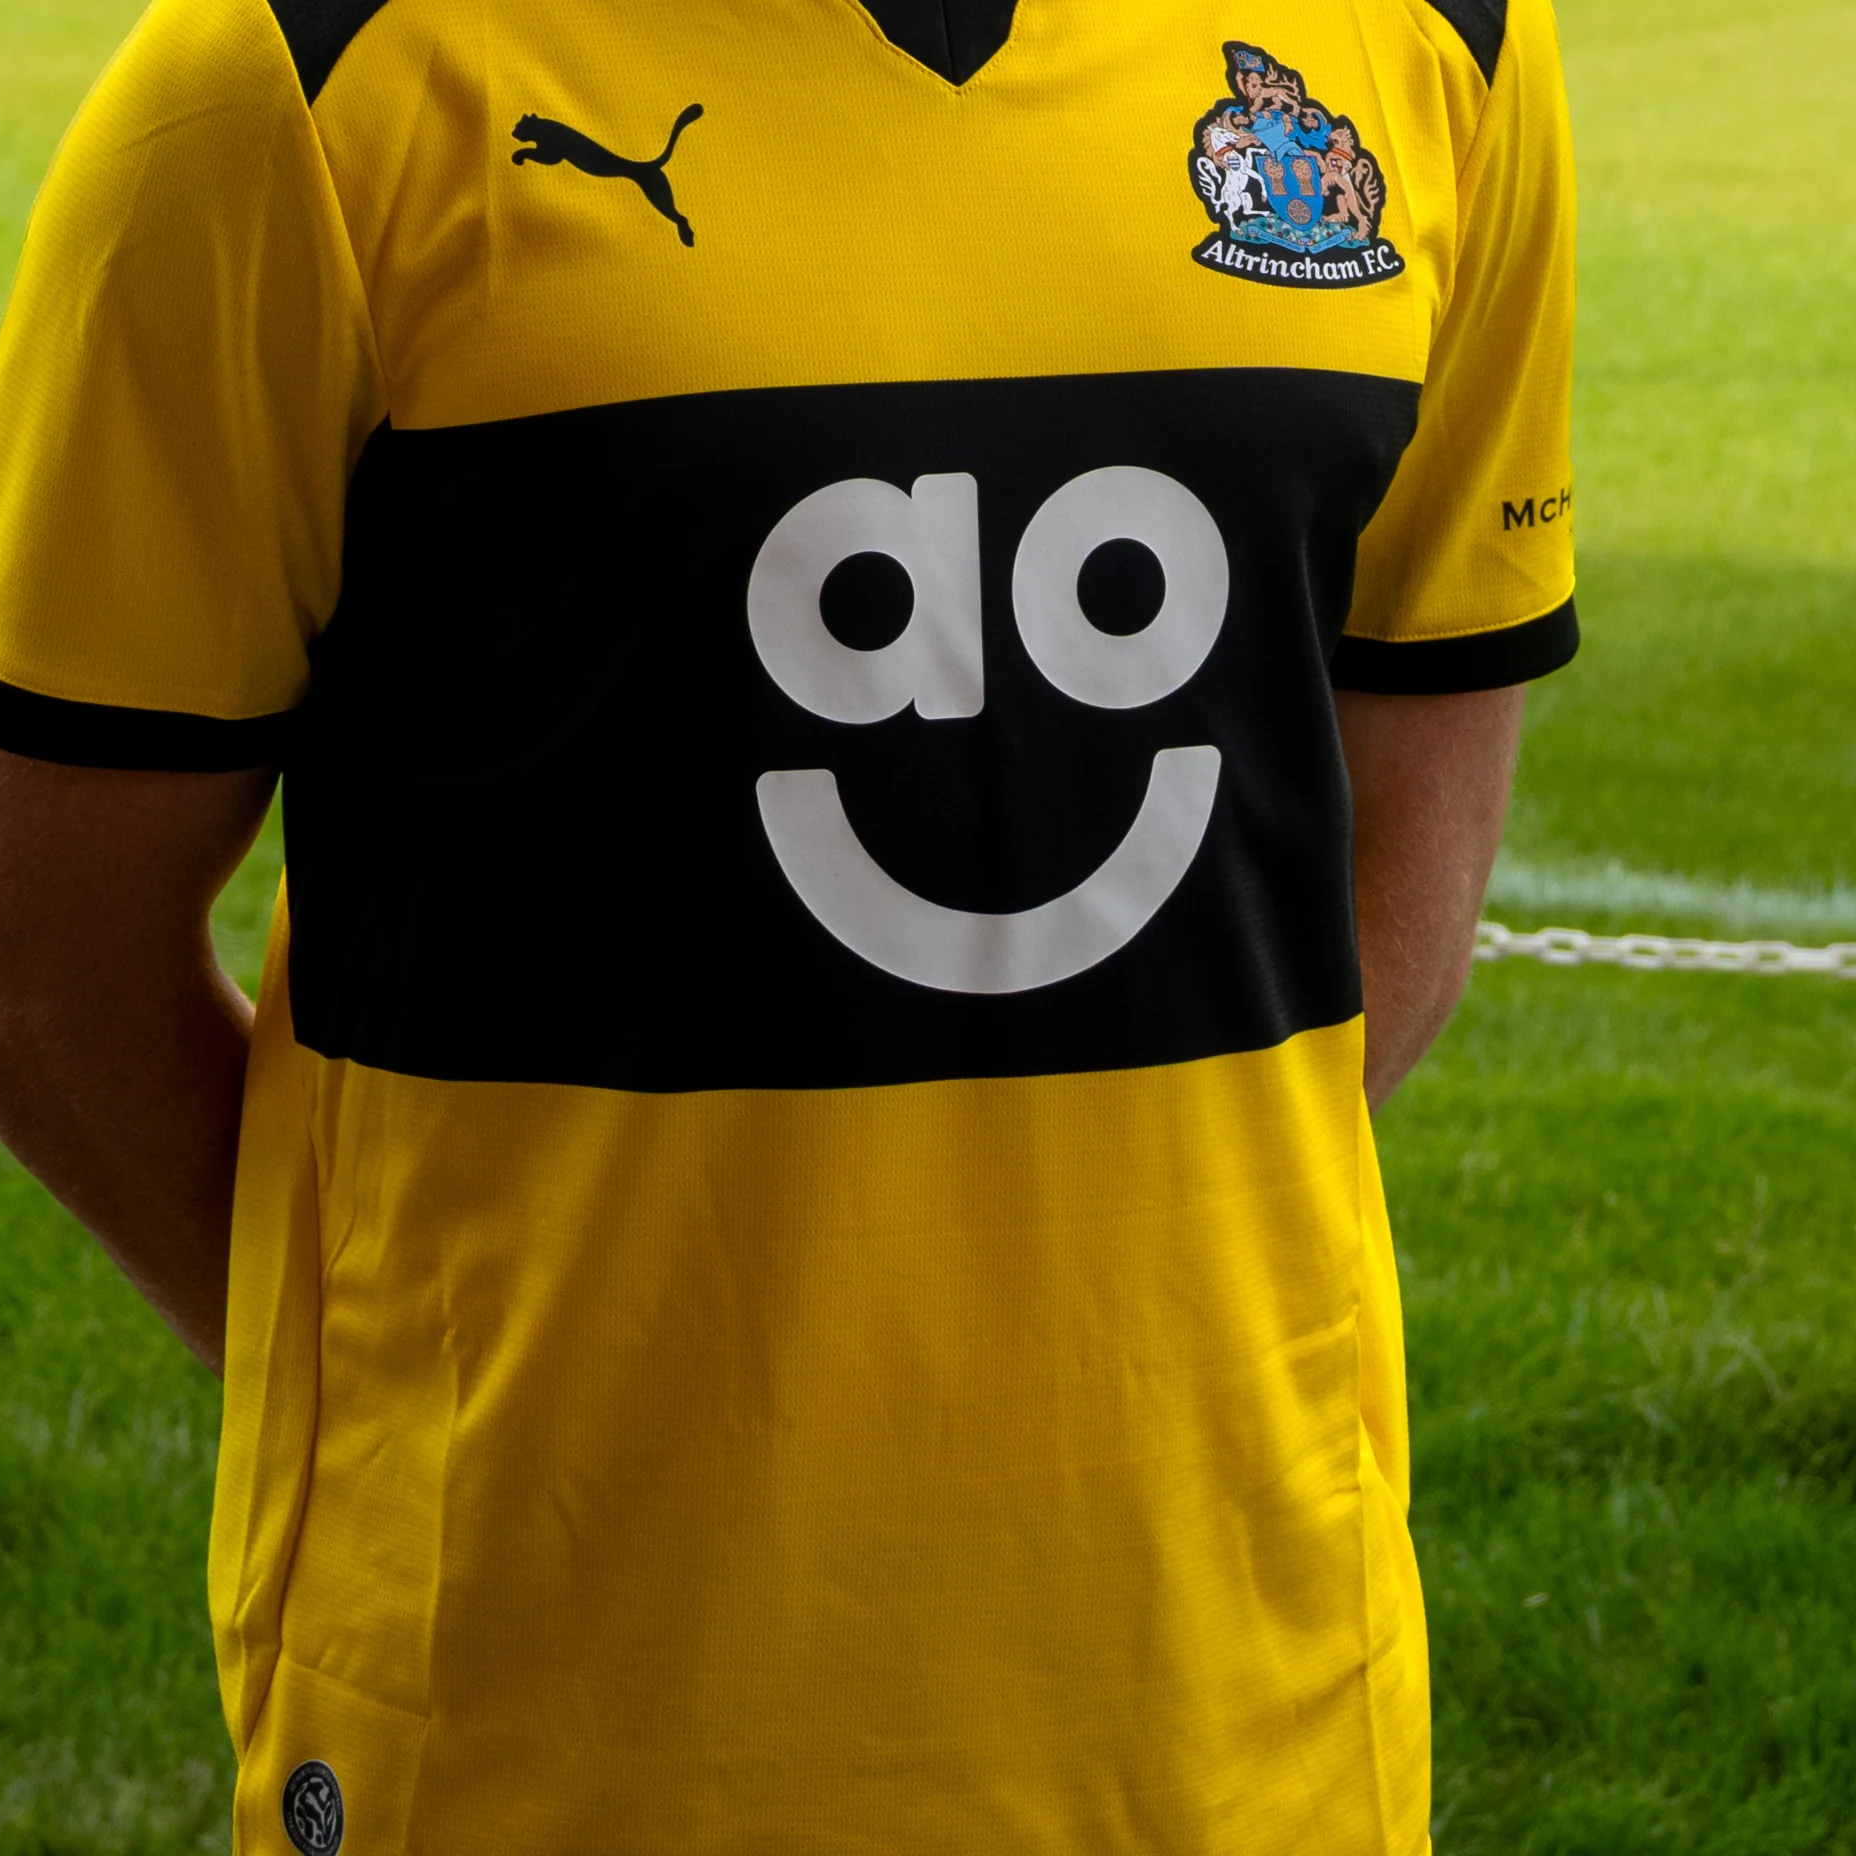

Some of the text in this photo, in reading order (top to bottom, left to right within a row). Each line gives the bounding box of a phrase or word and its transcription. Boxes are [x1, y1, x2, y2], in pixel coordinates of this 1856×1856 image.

[1200, 239, 1364, 280] Altrincham
[1361, 244, 1401, 276] F.C.
[746, 464, 1231, 725] ao
